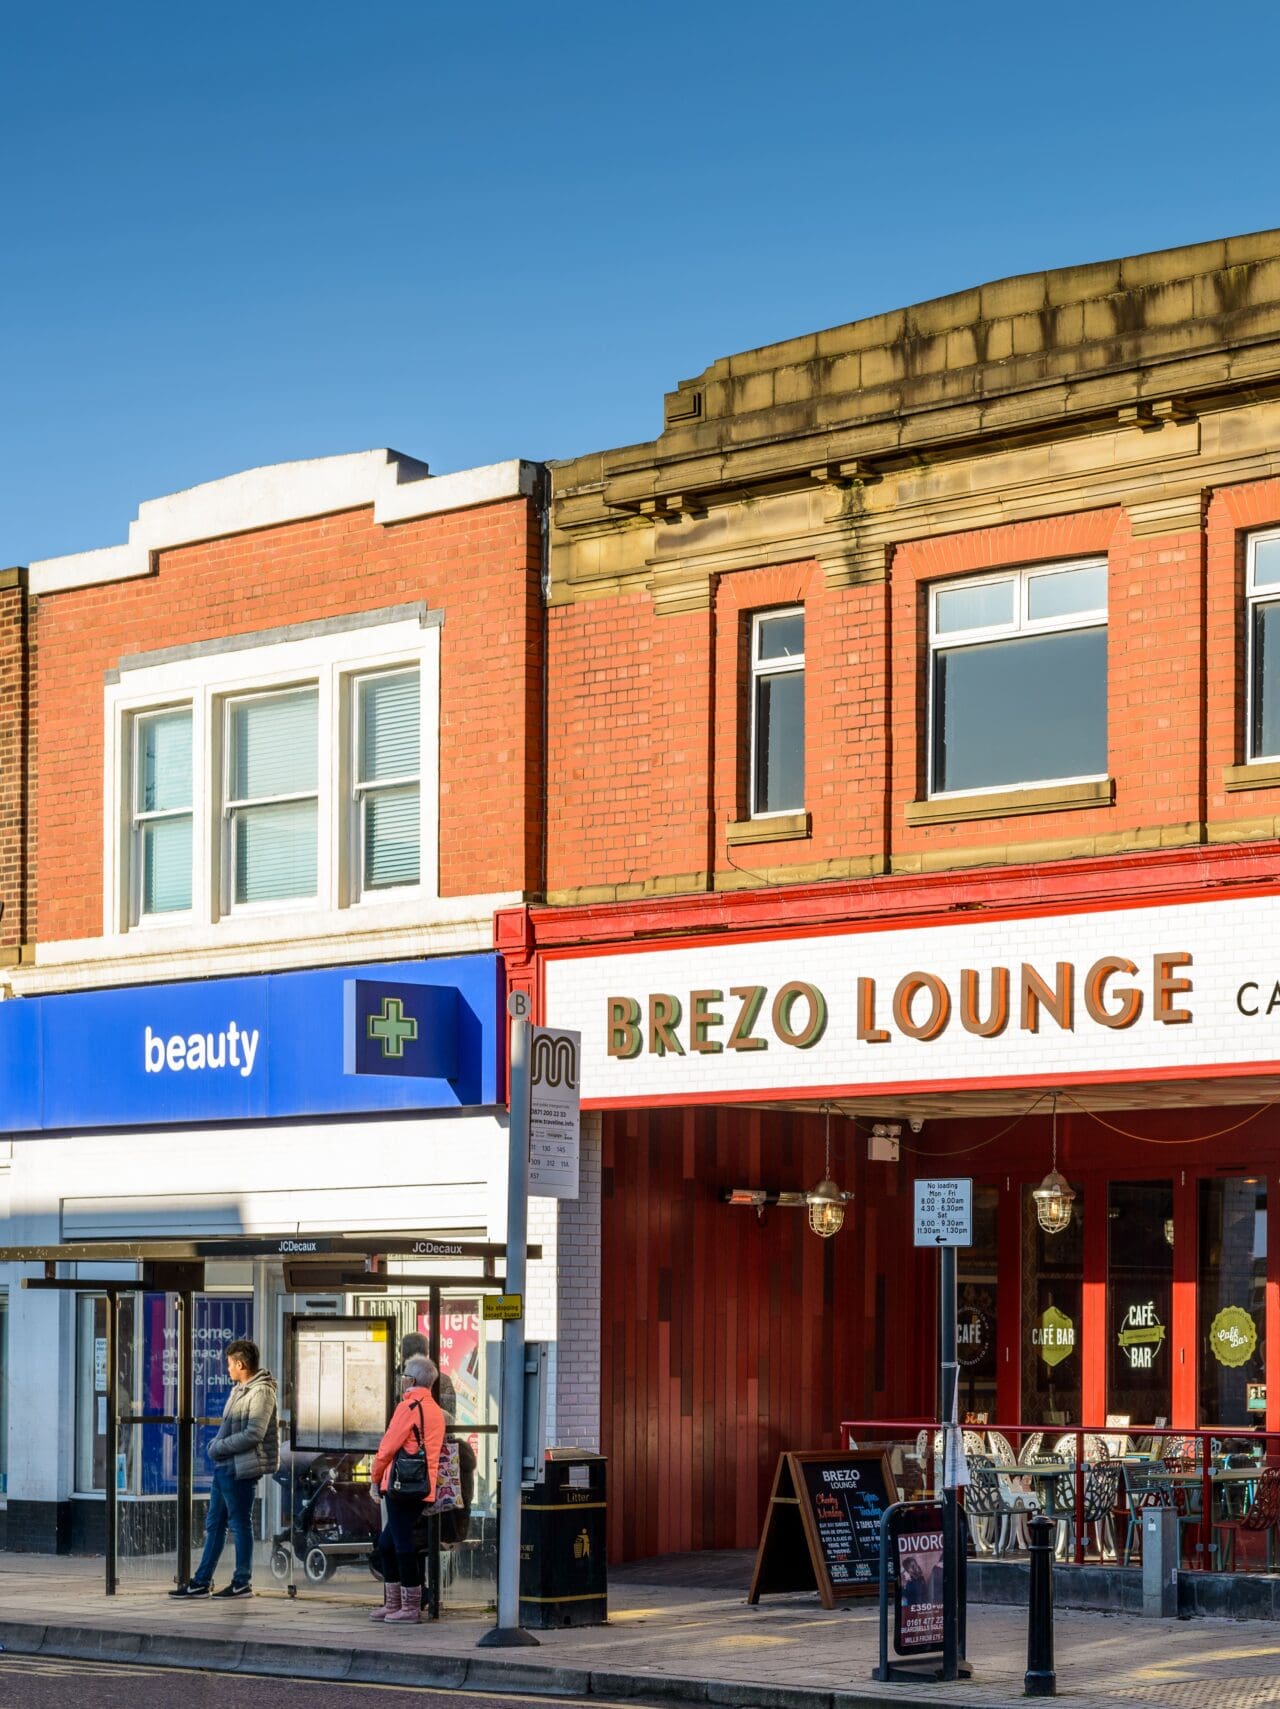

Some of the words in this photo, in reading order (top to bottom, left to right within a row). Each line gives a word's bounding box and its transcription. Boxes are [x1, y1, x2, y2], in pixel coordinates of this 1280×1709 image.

[515, 994, 526, 1015] B
[607, 980, 828, 1059] BREZO
[857, 952, 1194, 1043] LOUNGE
[145, 1021, 259, 1077] beauty
[278, 1241, 316, 1252] JCDecaux
[413, 1242, 462, 1254] JCDecaux
[1129, 1301, 1154, 1326] CAFÉ
[957, 1319, 981, 1343] CAFÉ
[1032, 1324, 1054, 1345] CAFÉ
[1056, 1328, 1075, 1345] BAR
[1217, 1326, 1239, 1342] Café
[1231, 1335, 1248, 1348] Bar
[1131, 1347, 1152, 1368] BAR
[822, 1469, 860, 1482] BREZO
[830, 1481, 857, 1489] LOUNGE
[567, 1493, 590, 1503] Litter
